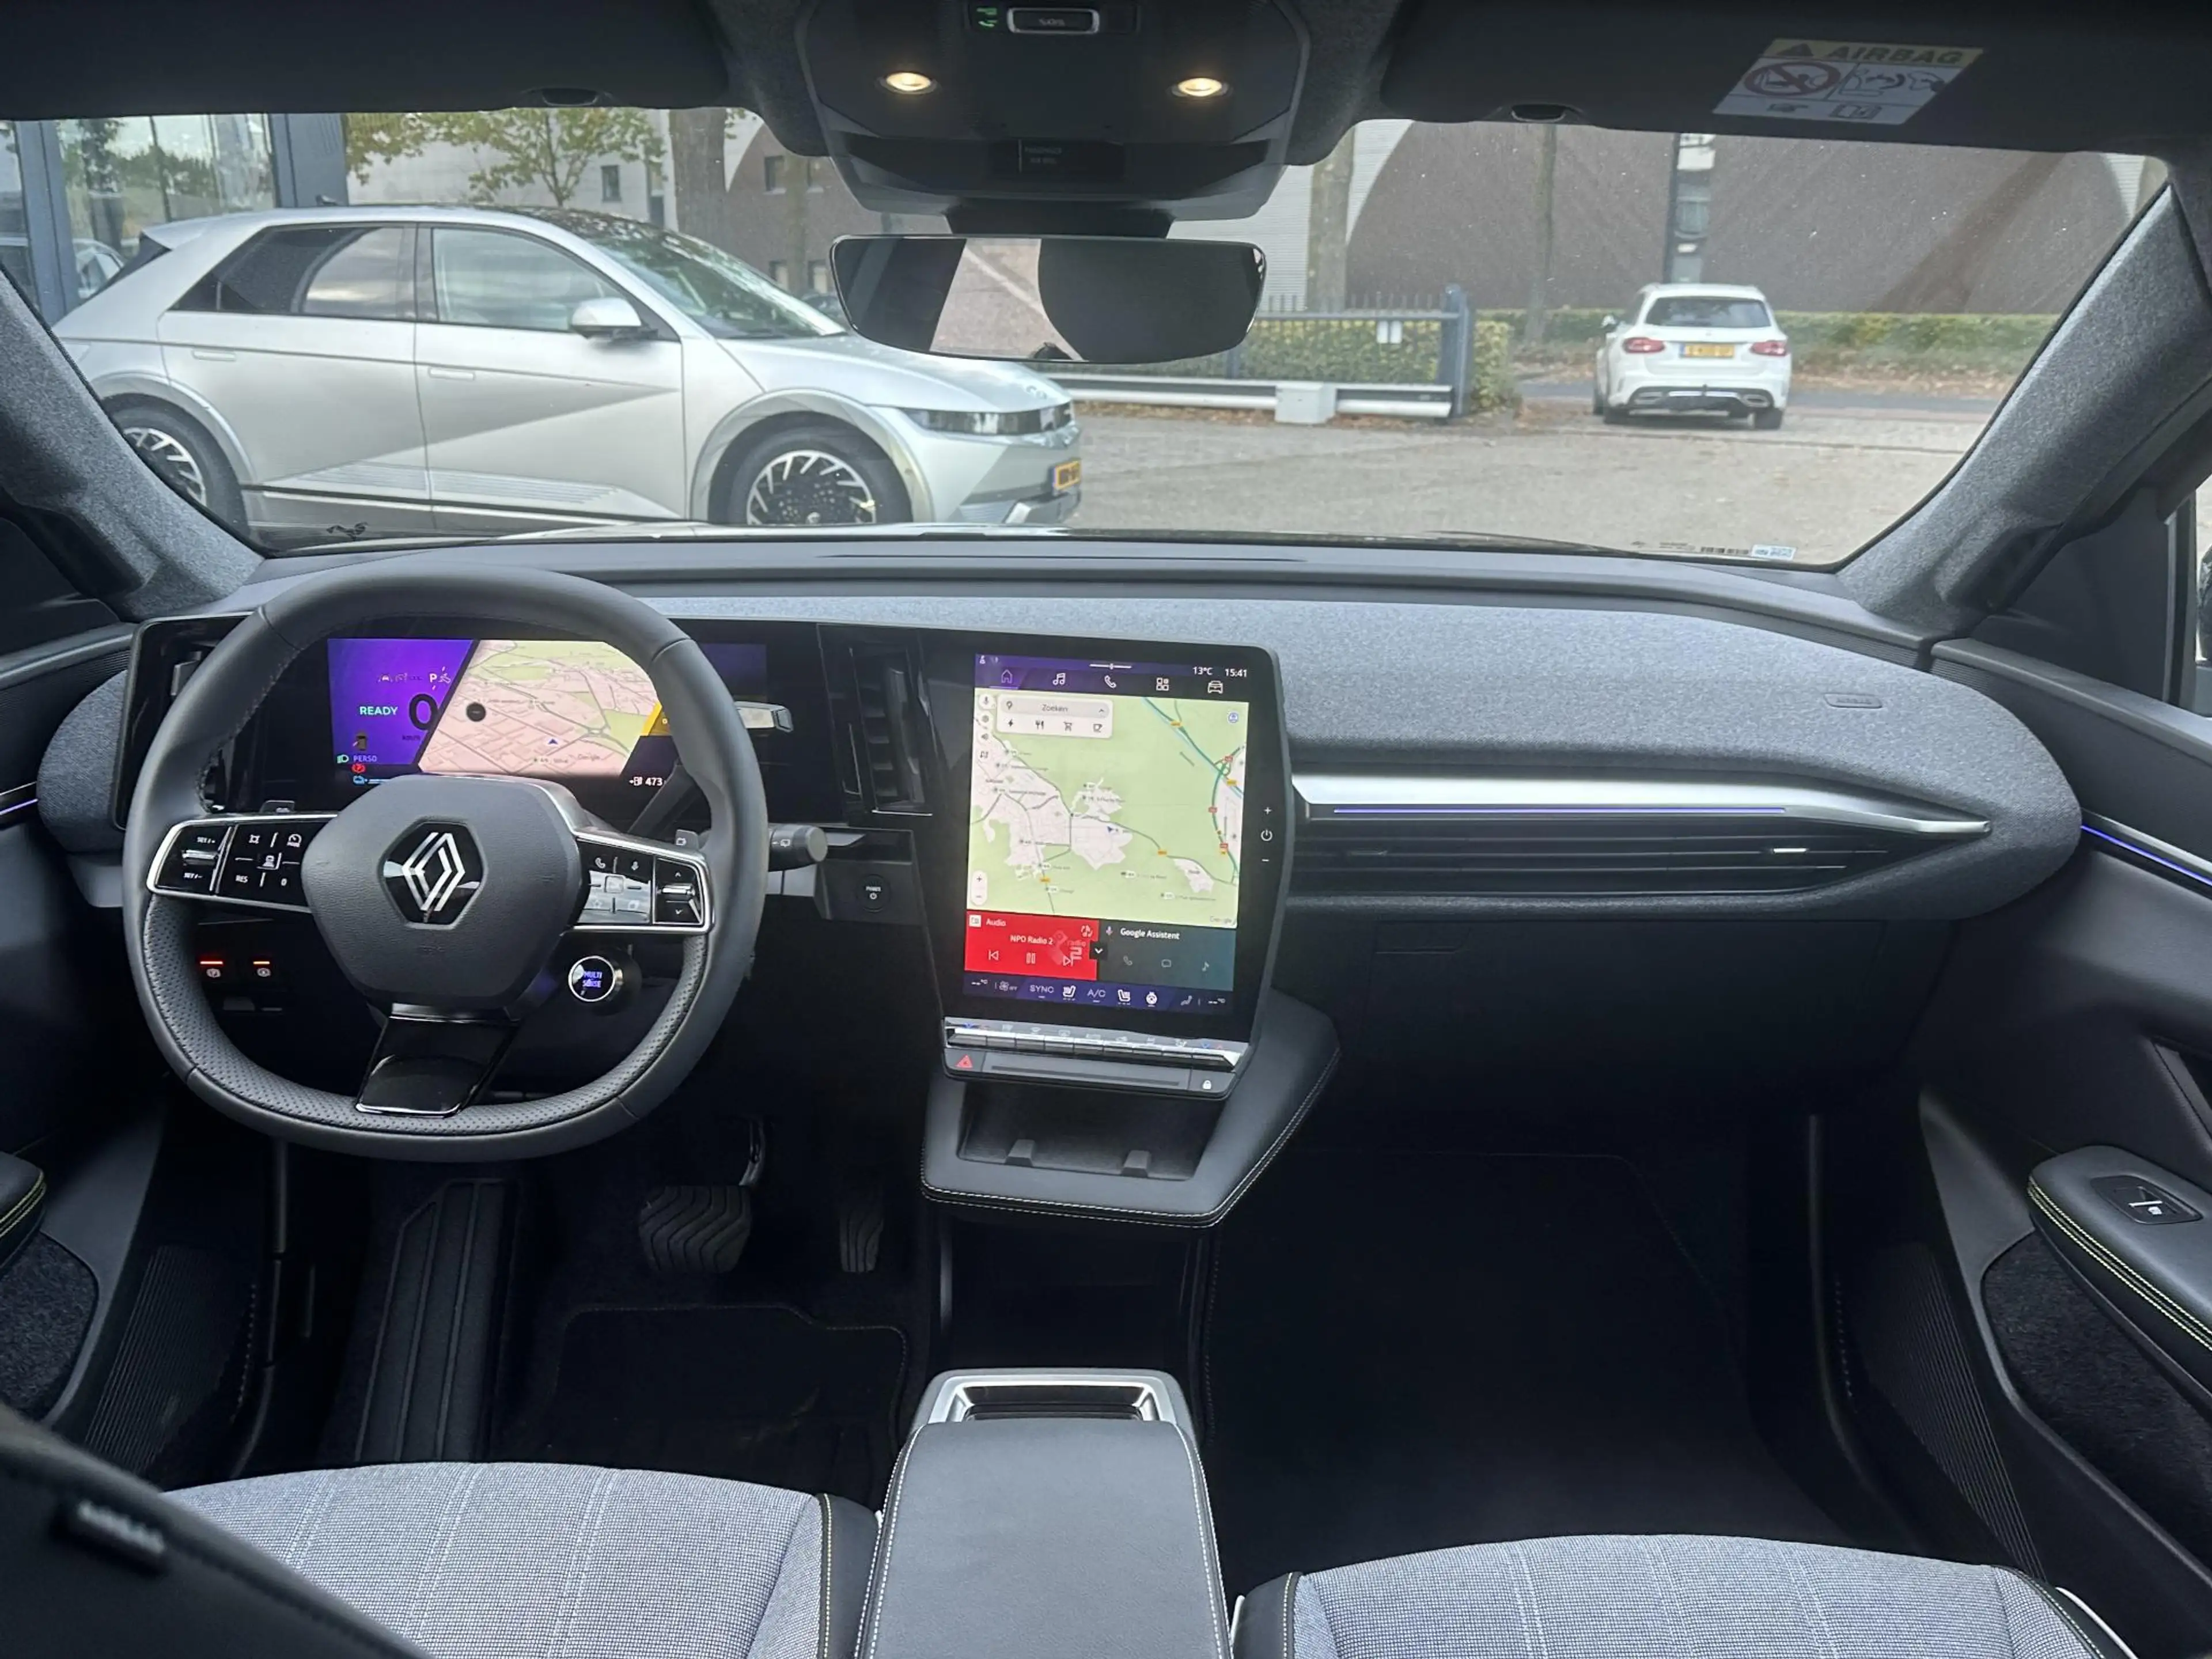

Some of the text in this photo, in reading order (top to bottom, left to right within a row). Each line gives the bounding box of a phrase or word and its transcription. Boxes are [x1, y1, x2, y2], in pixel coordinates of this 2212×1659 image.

[1825, 46, 1963, 63] AIRBAG
[1192, 666, 1213, 675] 13°C
[1225, 668, 1247, 677] 15:41
[429, 673, 437, 683] P
[359, 706, 398, 715] READY
[409, 693, 439, 731] 0
[1041, 704, 1069, 712] Zoeken
[645, 778, 663, 786] 473
[236, 875, 248, 884] RES
[986, 918, 1006, 927] Audio
[1120, 927, 1146, 938] Google
[1010, 935, 1053, 945] NPO Radio 2
[1029, 984, 1054, 993] SYNC
[1087, 989, 1106, 998] A/C
